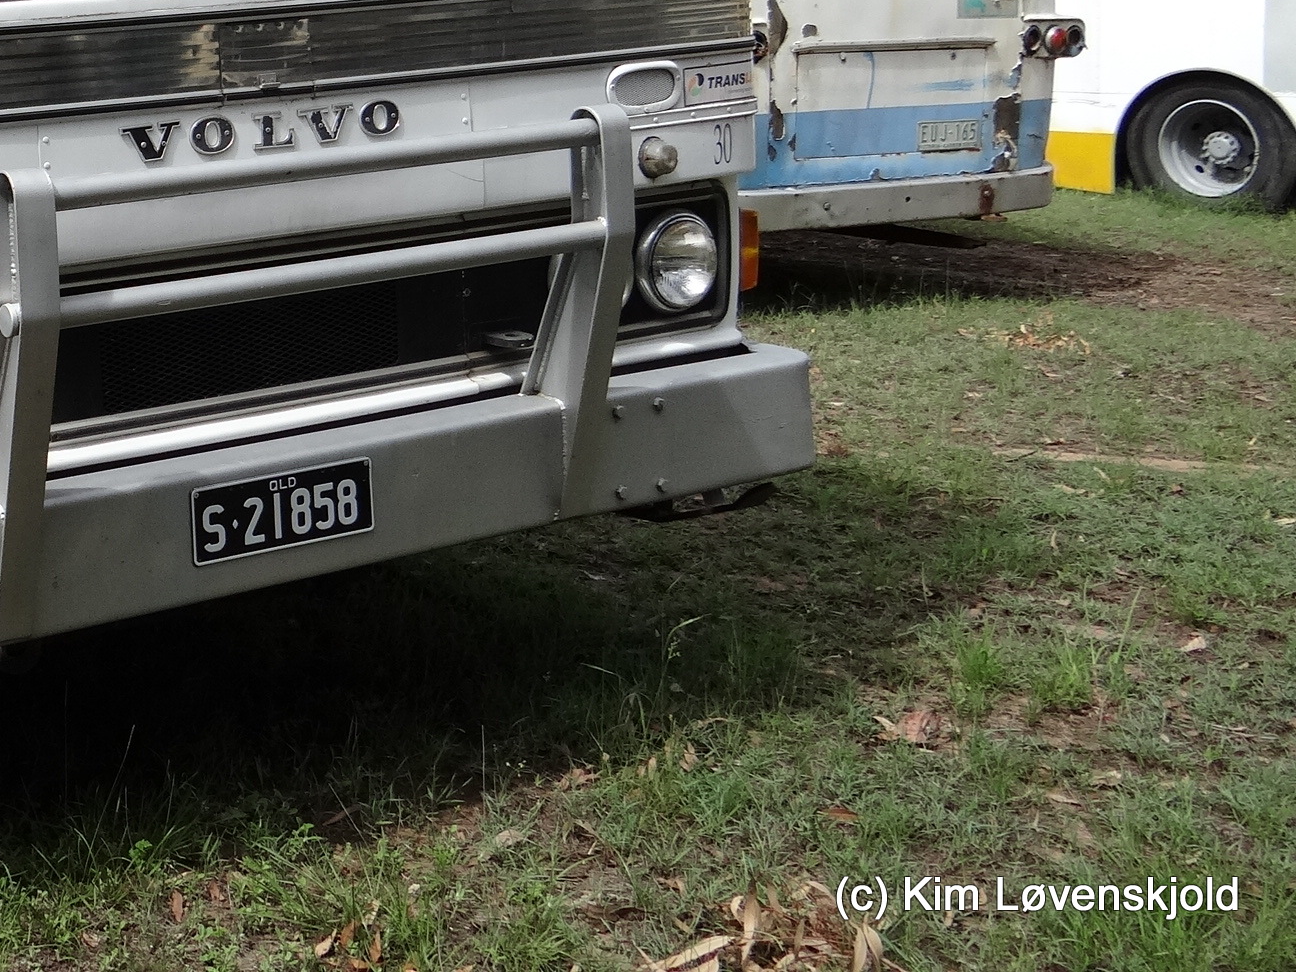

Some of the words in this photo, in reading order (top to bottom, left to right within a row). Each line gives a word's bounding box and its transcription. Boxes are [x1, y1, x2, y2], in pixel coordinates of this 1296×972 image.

[119, 100, 400, 163] VOLVO
[713, 123, 732, 165] 30
[921, 121, 976, 143] EUJ-165
[269, 477, 297, 491] QLD
